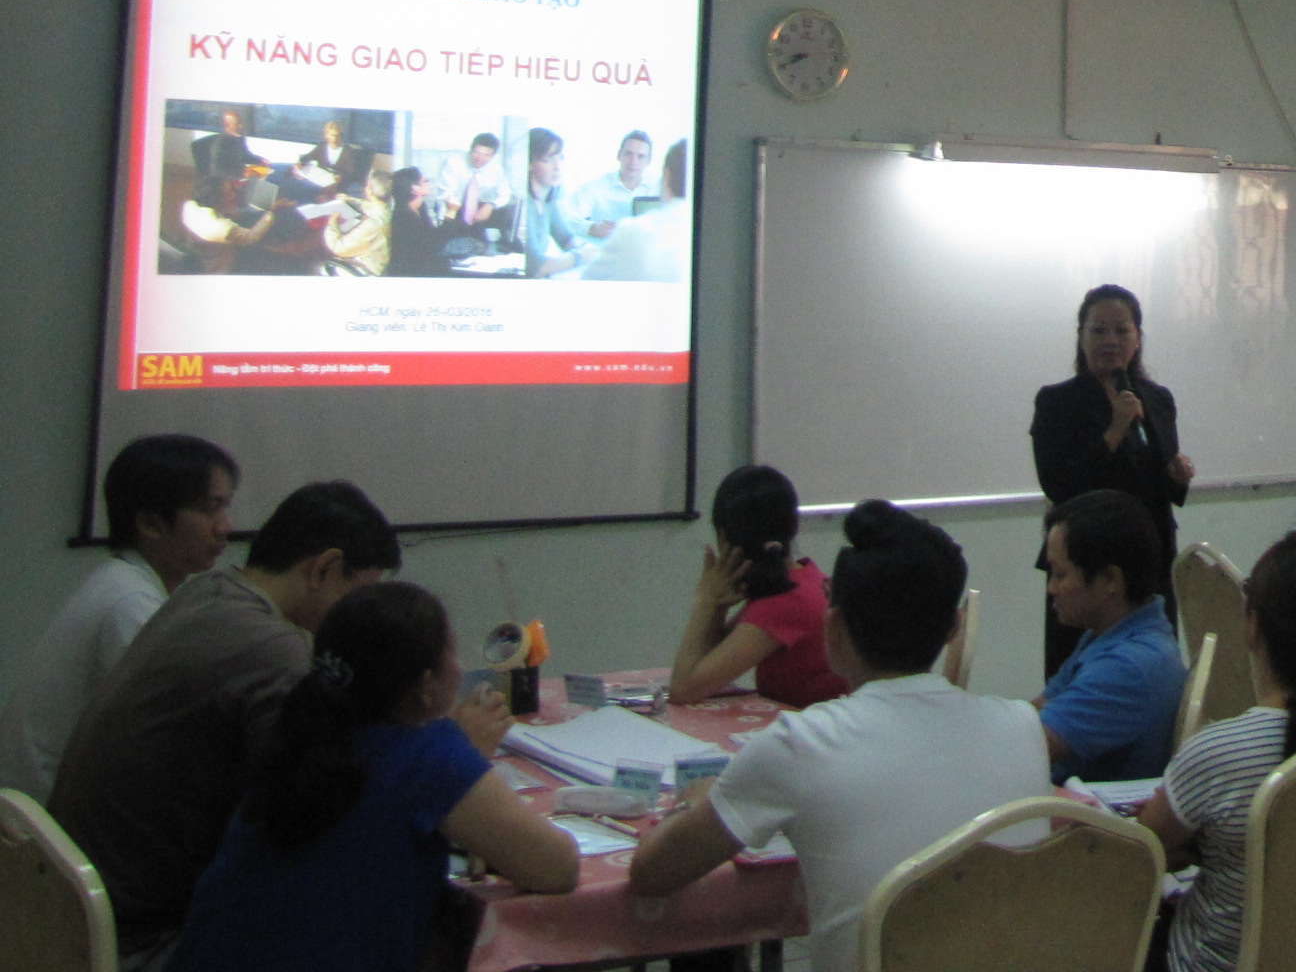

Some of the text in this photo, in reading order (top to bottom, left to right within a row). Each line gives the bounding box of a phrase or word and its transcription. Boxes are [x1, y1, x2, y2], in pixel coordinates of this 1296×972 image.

[189, 30, 235, 61] KỸ
[245, 34, 338, 67] NĂNG
[351, 44, 428, 73] GIAO
[591, 58, 653, 87] QUẢ
[142, 354, 203, 378] SAM
